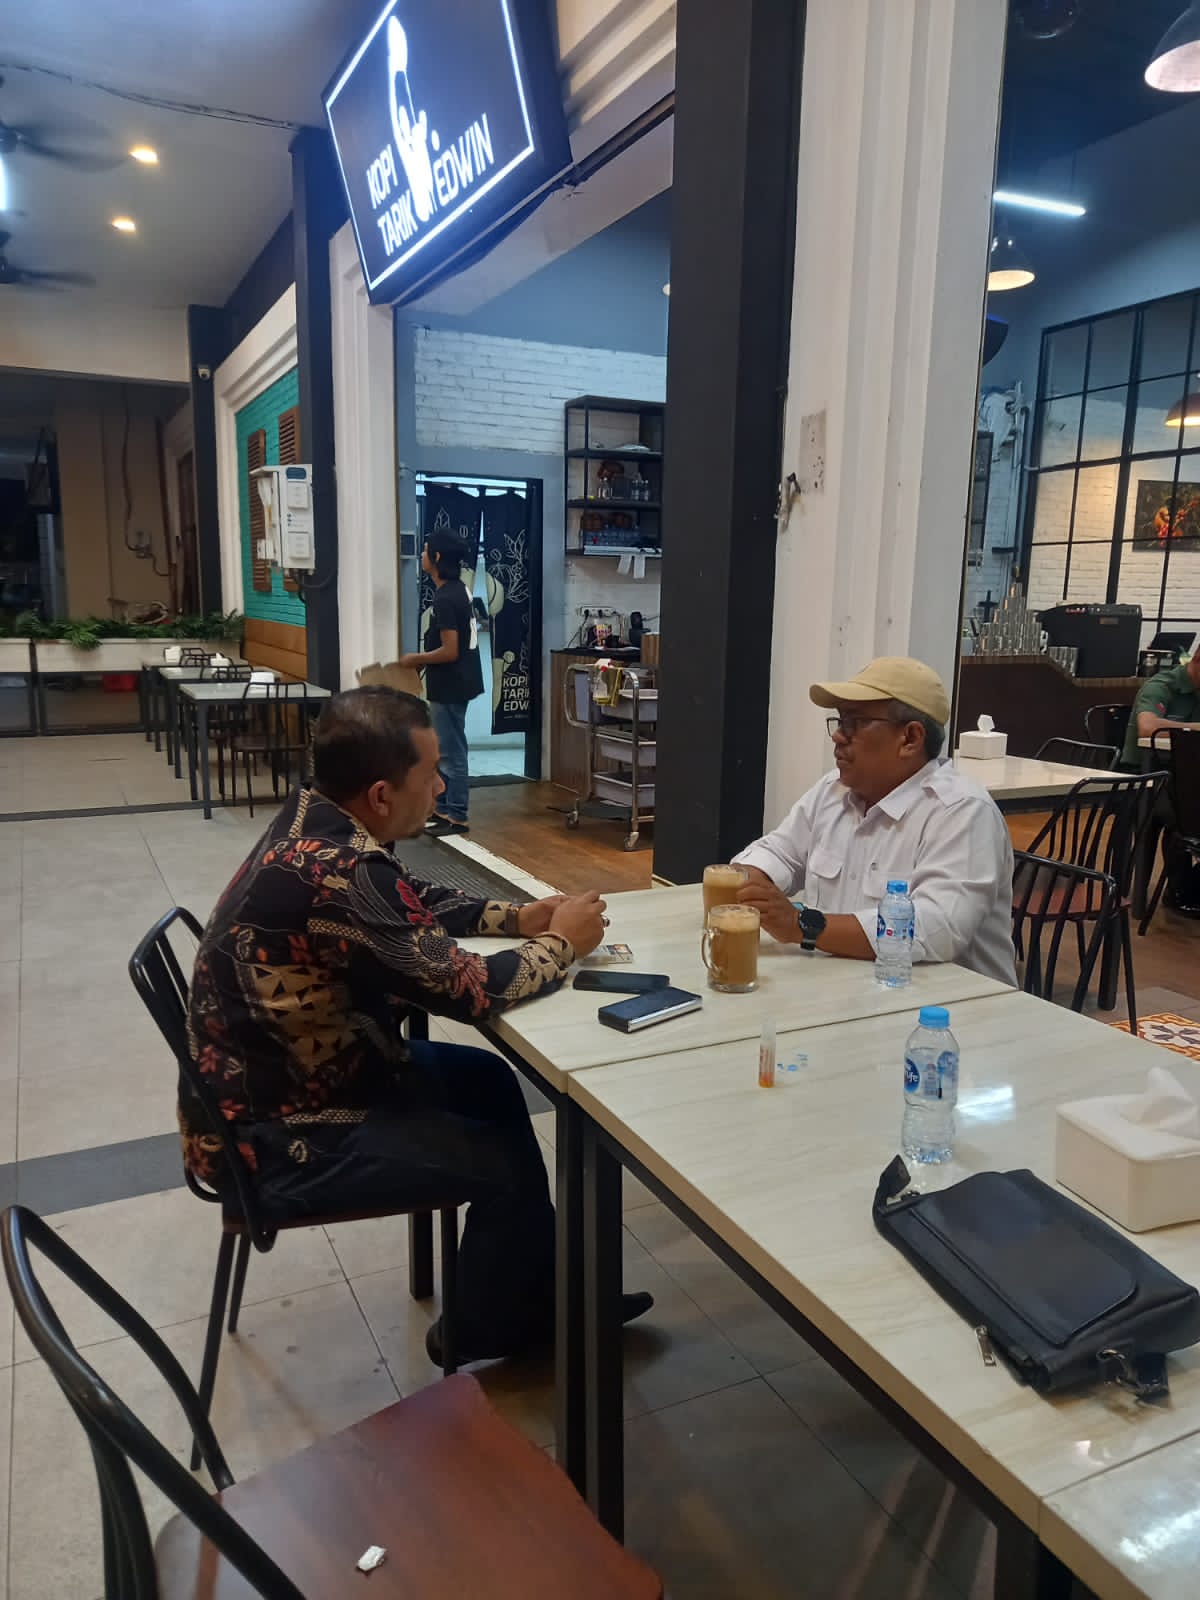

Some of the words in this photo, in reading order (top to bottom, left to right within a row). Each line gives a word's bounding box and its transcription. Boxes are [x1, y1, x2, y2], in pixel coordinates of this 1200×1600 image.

[366, 143, 398, 209] KOPI
[377, 189, 418, 256] TARIK
[433, 112, 494, 207] EDWIN
[503, 675, 528, 687] KOPI
